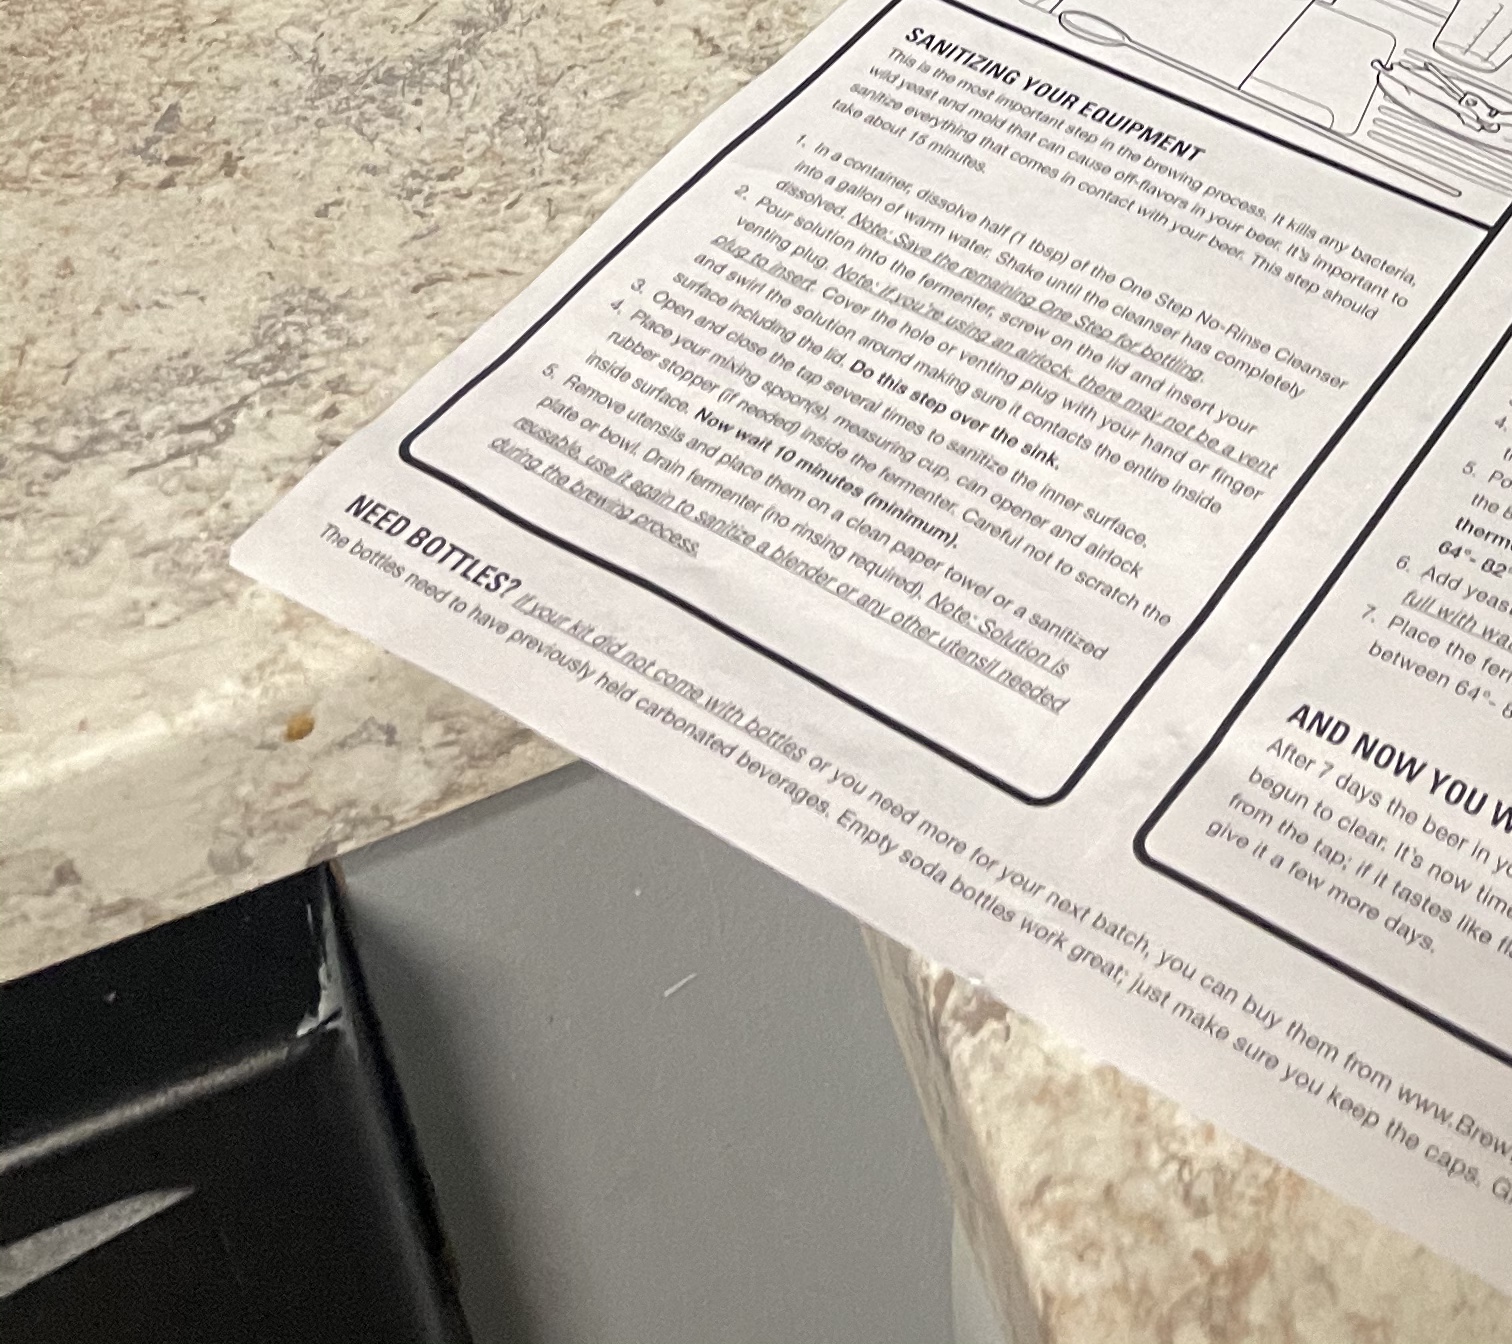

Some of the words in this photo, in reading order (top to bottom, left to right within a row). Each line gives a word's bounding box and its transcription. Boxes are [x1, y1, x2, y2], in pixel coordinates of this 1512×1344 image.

[904, 27, 1021, 85] SANITIZING
[1021, 75, 1080, 110] YOUR
[1077, 100, 1206, 161] EQUIPMENT
[887, 46, 917, 68] This
[915, 60, 931, 74] is
[931, 67, 956, 84] the
[955, 78, 995, 100] most
[993, 93, 1065, 130] important
[1064, 124, 1098, 144] step
[1099, 136, 1115, 151] in
[1116, 144, 1142, 162] the
[1142, 155, 1203, 193] brewing
[1201, 185, 1266, 221] process.
[1271, 211, 1285, 226] It
[1285, 216, 1317, 239] kills
[1317, 234, 1350, 254] any
[1350, 244, 1416, 287] bacteria,
[584, 350, 631, 382] inside
[631, 377, 689, 414] surface.
[693, 405, 735, 433] Now
[734, 427, 773, 453] wait
[773, 445, 797, 463] 10
[794, 457, 864, 498] minutes
[862, 491, 959, 549] (minimum).
[344, 493, 411, 537] NEED
[404, 526, 522, 597] BOTTLES?
[1286, 703, 1350, 745] AND
[1350, 731, 1427, 783] NOW
[1428, 767, 1488, 815] YOU
